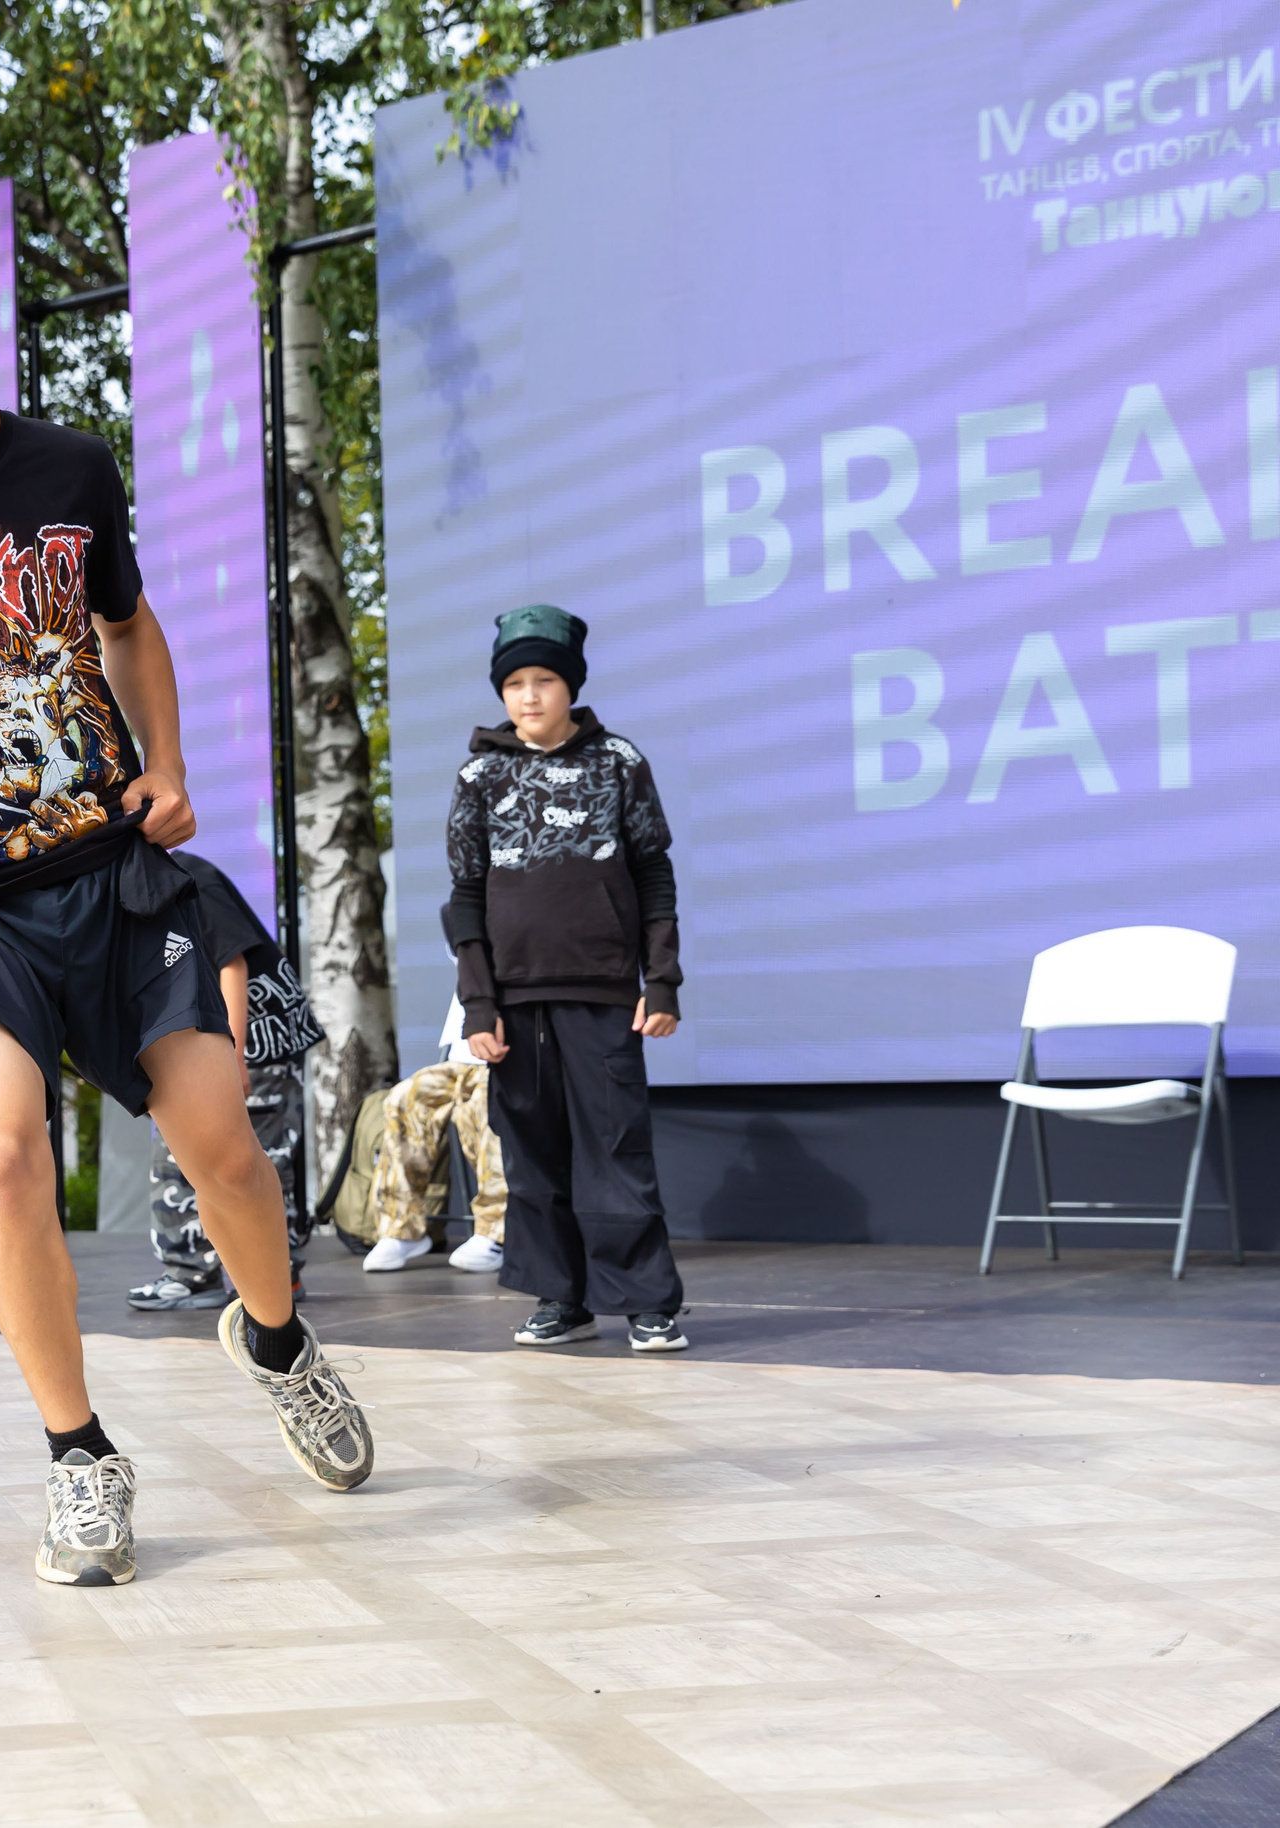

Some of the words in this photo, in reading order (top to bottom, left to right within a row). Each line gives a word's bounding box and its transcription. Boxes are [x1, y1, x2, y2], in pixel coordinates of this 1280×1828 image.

[978, 99, 1036, 162] IV
[1045, 47, 1274, 145] ФЕСТИ
[1032, 168, 1280, 256] Танцую
[851, 609, 1280, 813] BAT
[164, 940, 194, 968] adida
